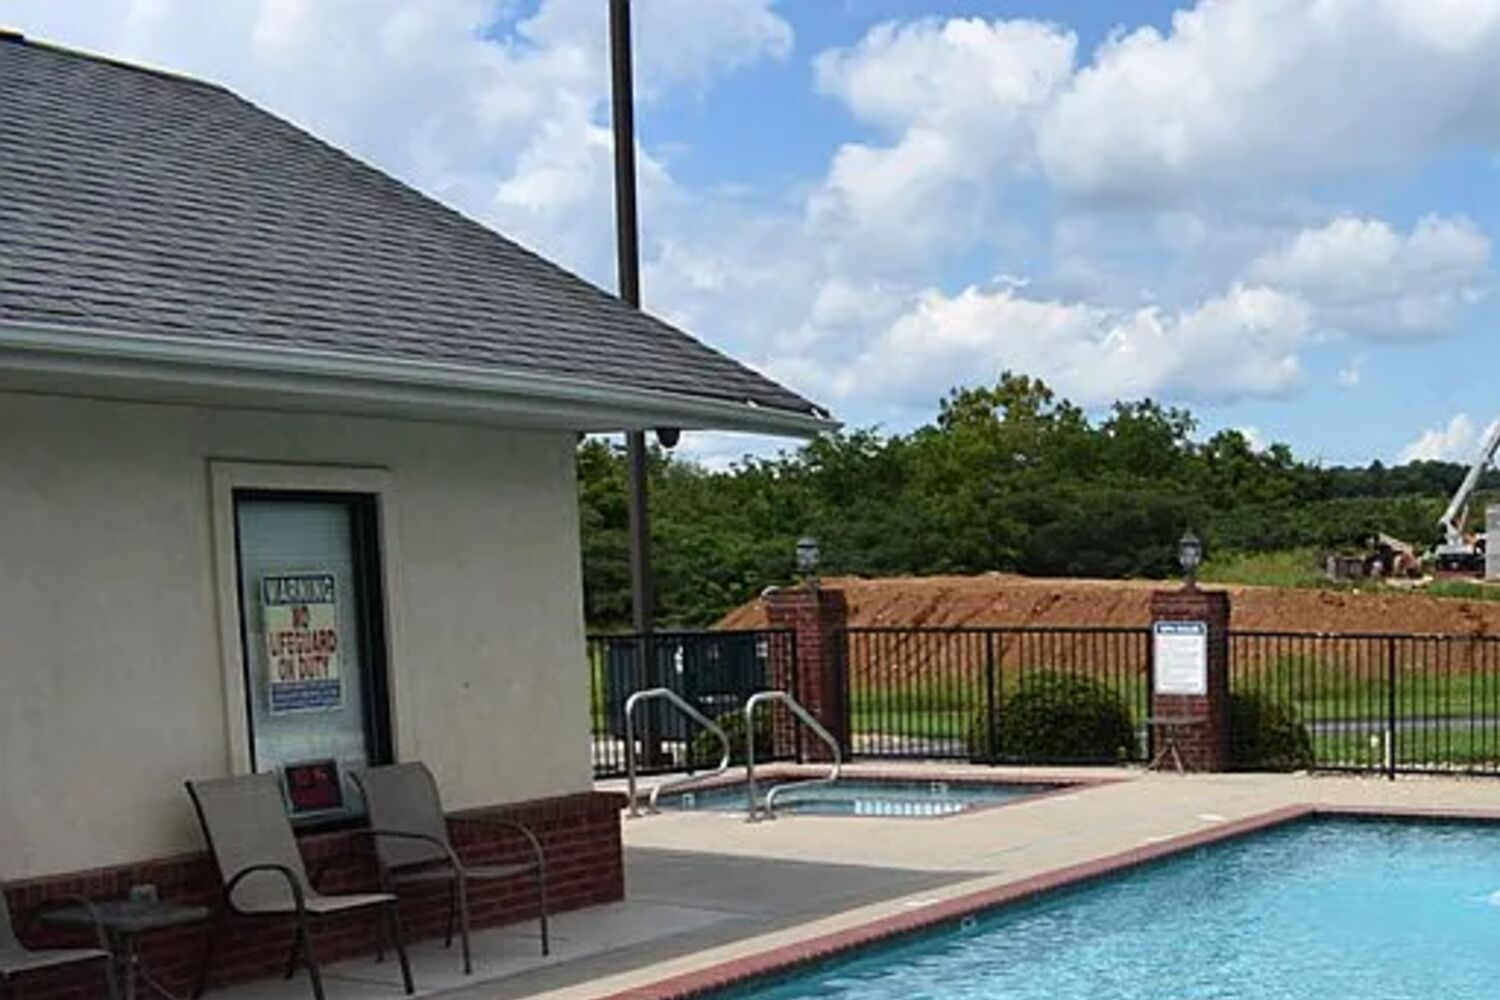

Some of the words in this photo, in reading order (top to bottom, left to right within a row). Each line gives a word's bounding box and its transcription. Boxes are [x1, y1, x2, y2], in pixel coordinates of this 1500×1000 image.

[264, 577, 335, 603] WARNING
[293, 606, 310, 628] NO
[269, 630, 337, 656] LIFEGUARD
[279, 658, 295, 680] ON
[299, 656, 329, 679] DUTY
